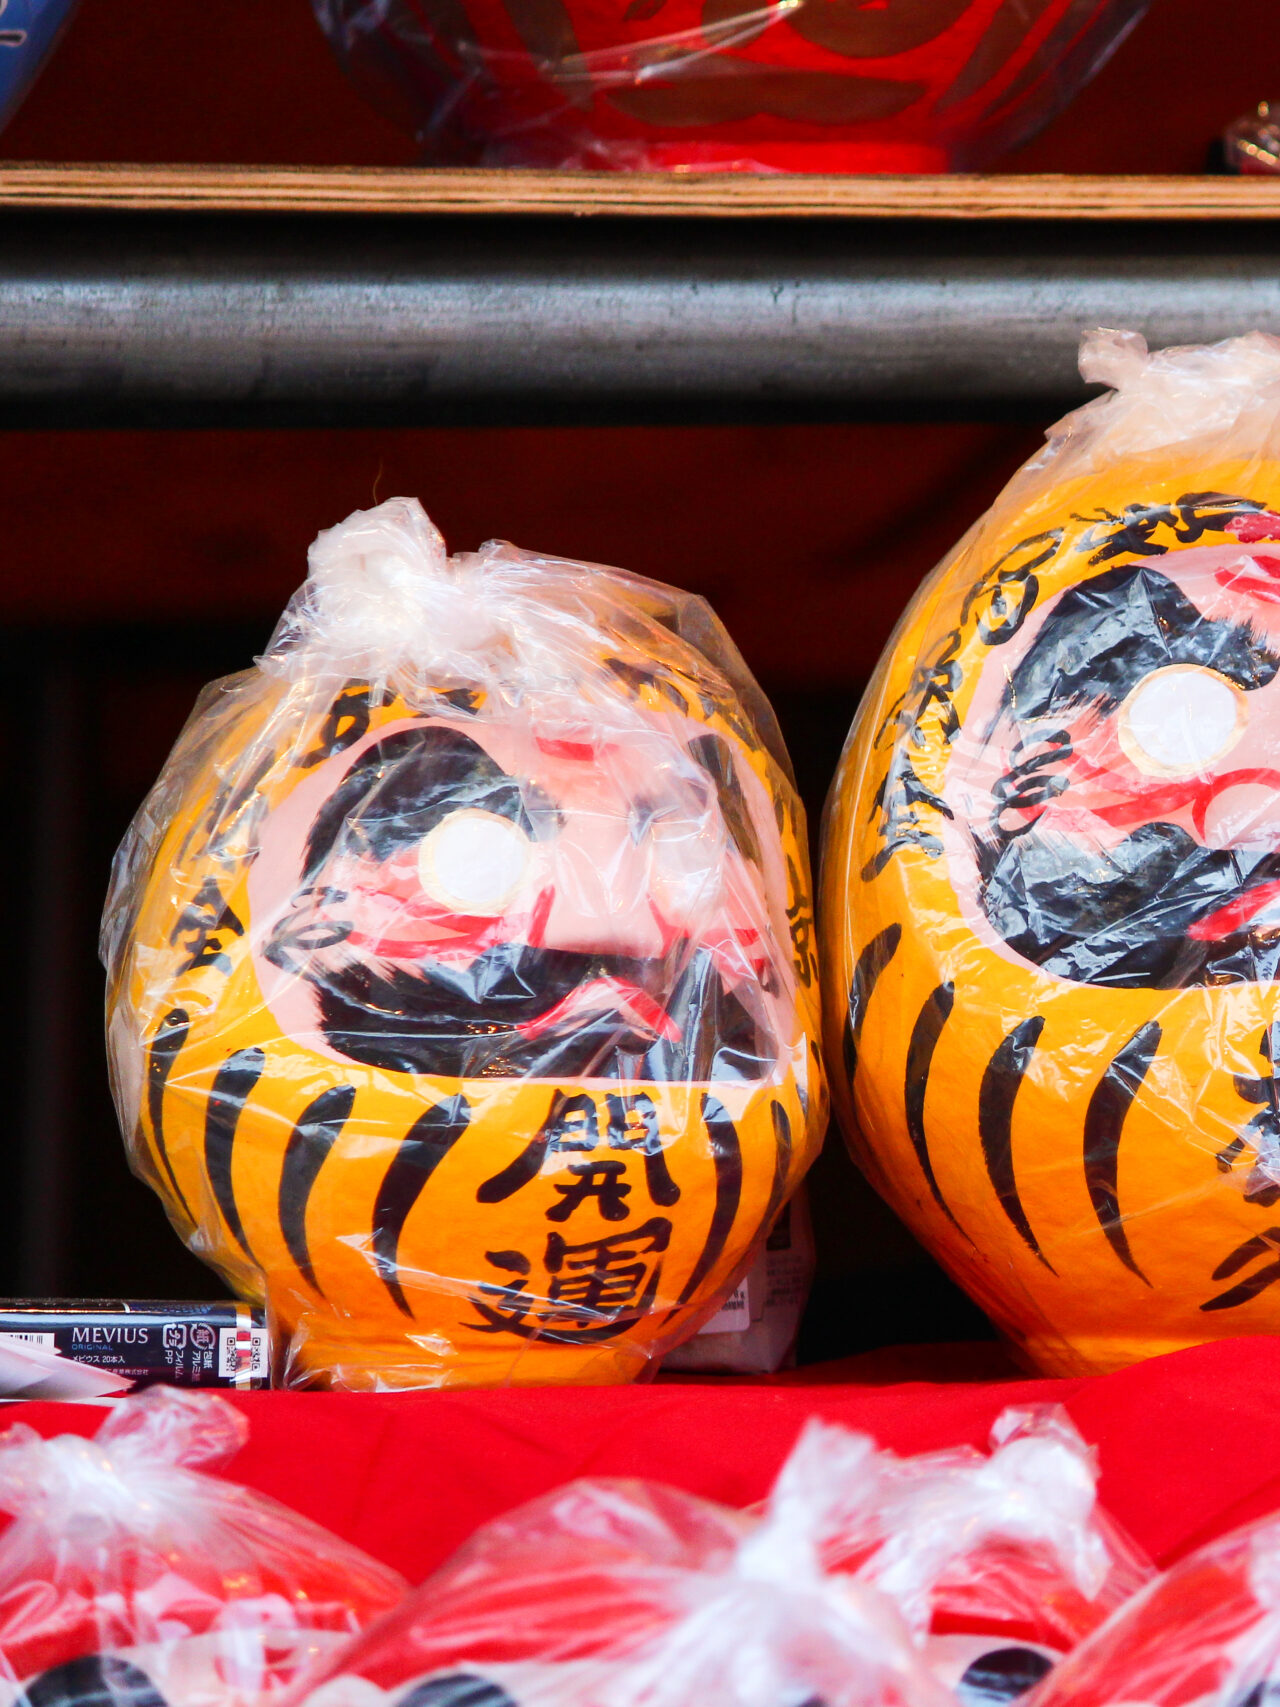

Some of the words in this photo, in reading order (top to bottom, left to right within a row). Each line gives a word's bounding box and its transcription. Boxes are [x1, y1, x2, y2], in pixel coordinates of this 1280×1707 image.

[458, 1089, 681, 1345] 開運
[71, 1327, 149, 1344] MEVIUS
[102, 1355, 126, 1364] 20本入
[165, 1350, 173, 1364] PP
